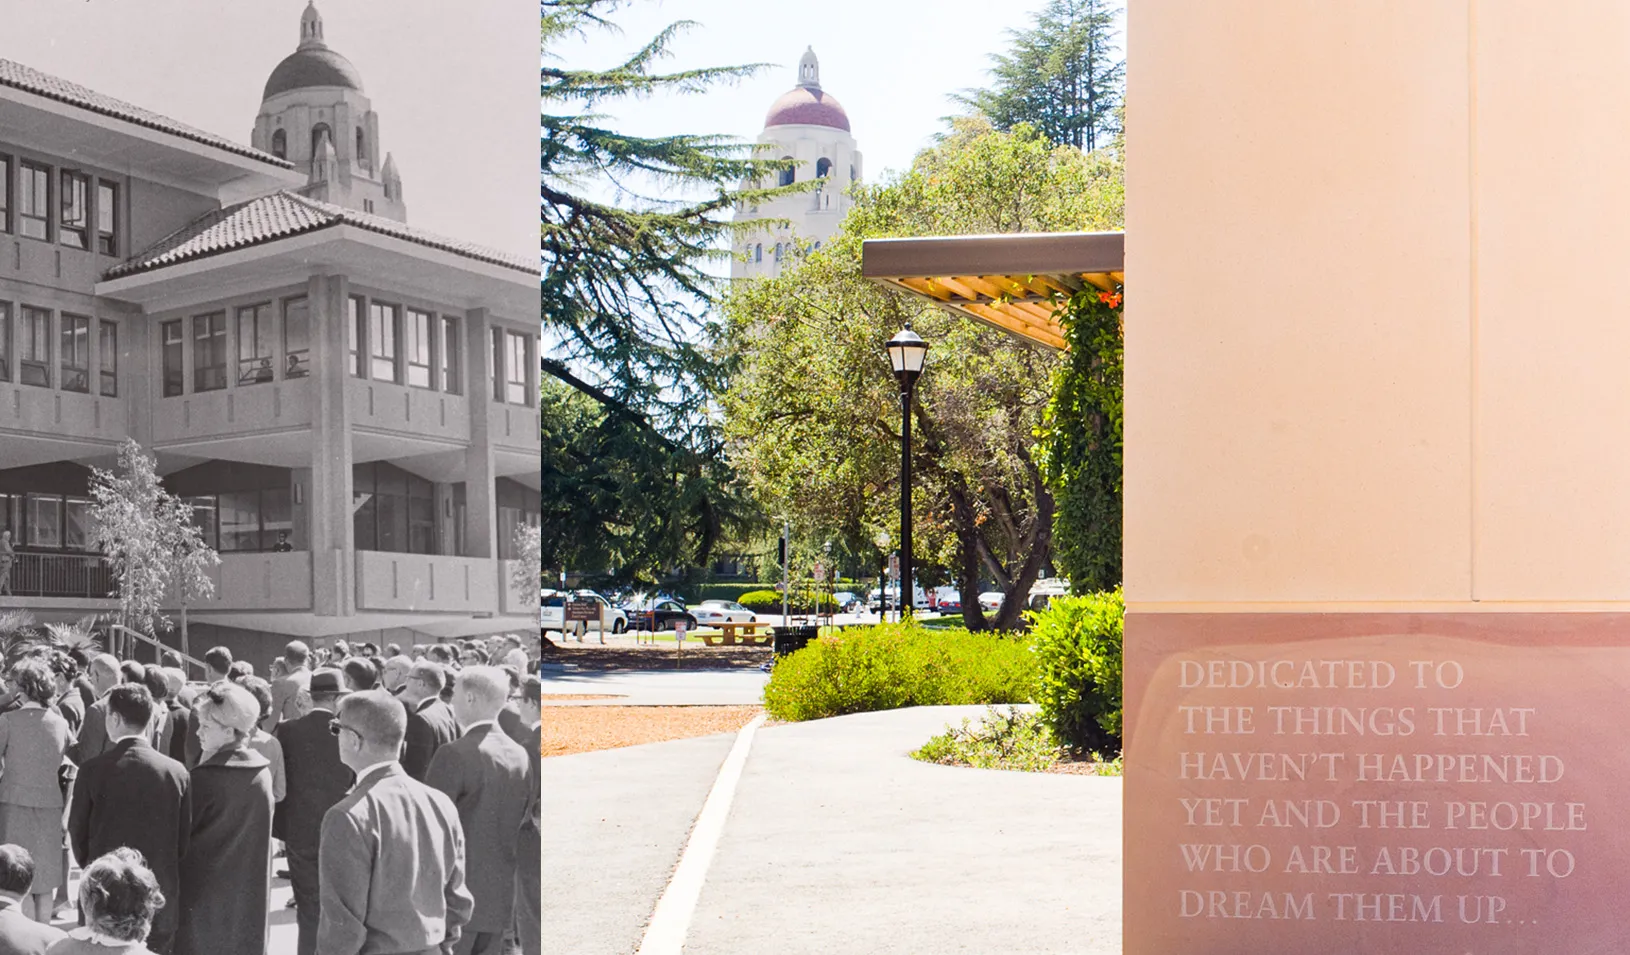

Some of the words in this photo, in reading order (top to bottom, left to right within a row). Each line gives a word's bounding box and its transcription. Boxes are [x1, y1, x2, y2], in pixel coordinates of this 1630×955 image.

[1178, 660, 1396, 689] DEDICATED
[1408, 660, 1464, 689] TO
[1178, 705, 1255, 735] THE
[1267, 707, 1415, 737] THINGS
[1427, 707, 1536, 737] THAT
[1178, 752, 1344, 782] HAVEN'T
[1355, 754, 1564, 784] HAPPENED
[1179, 798, 1249, 827] YET
[1256, 799, 1340, 829] AND
[1352, 800, 1430, 830] THE
[1443, 801, 1587, 831] PEOPLE
[1179, 844, 1271, 873] WHO
[1285, 845, 1359, 875] ARE
[1370, 846, 1508, 877] ABOUT
[1520, 848, 1575, 878] TO
[1178, 890, 1317, 920] DREAM
[1329, 893, 1444, 923] THEM
